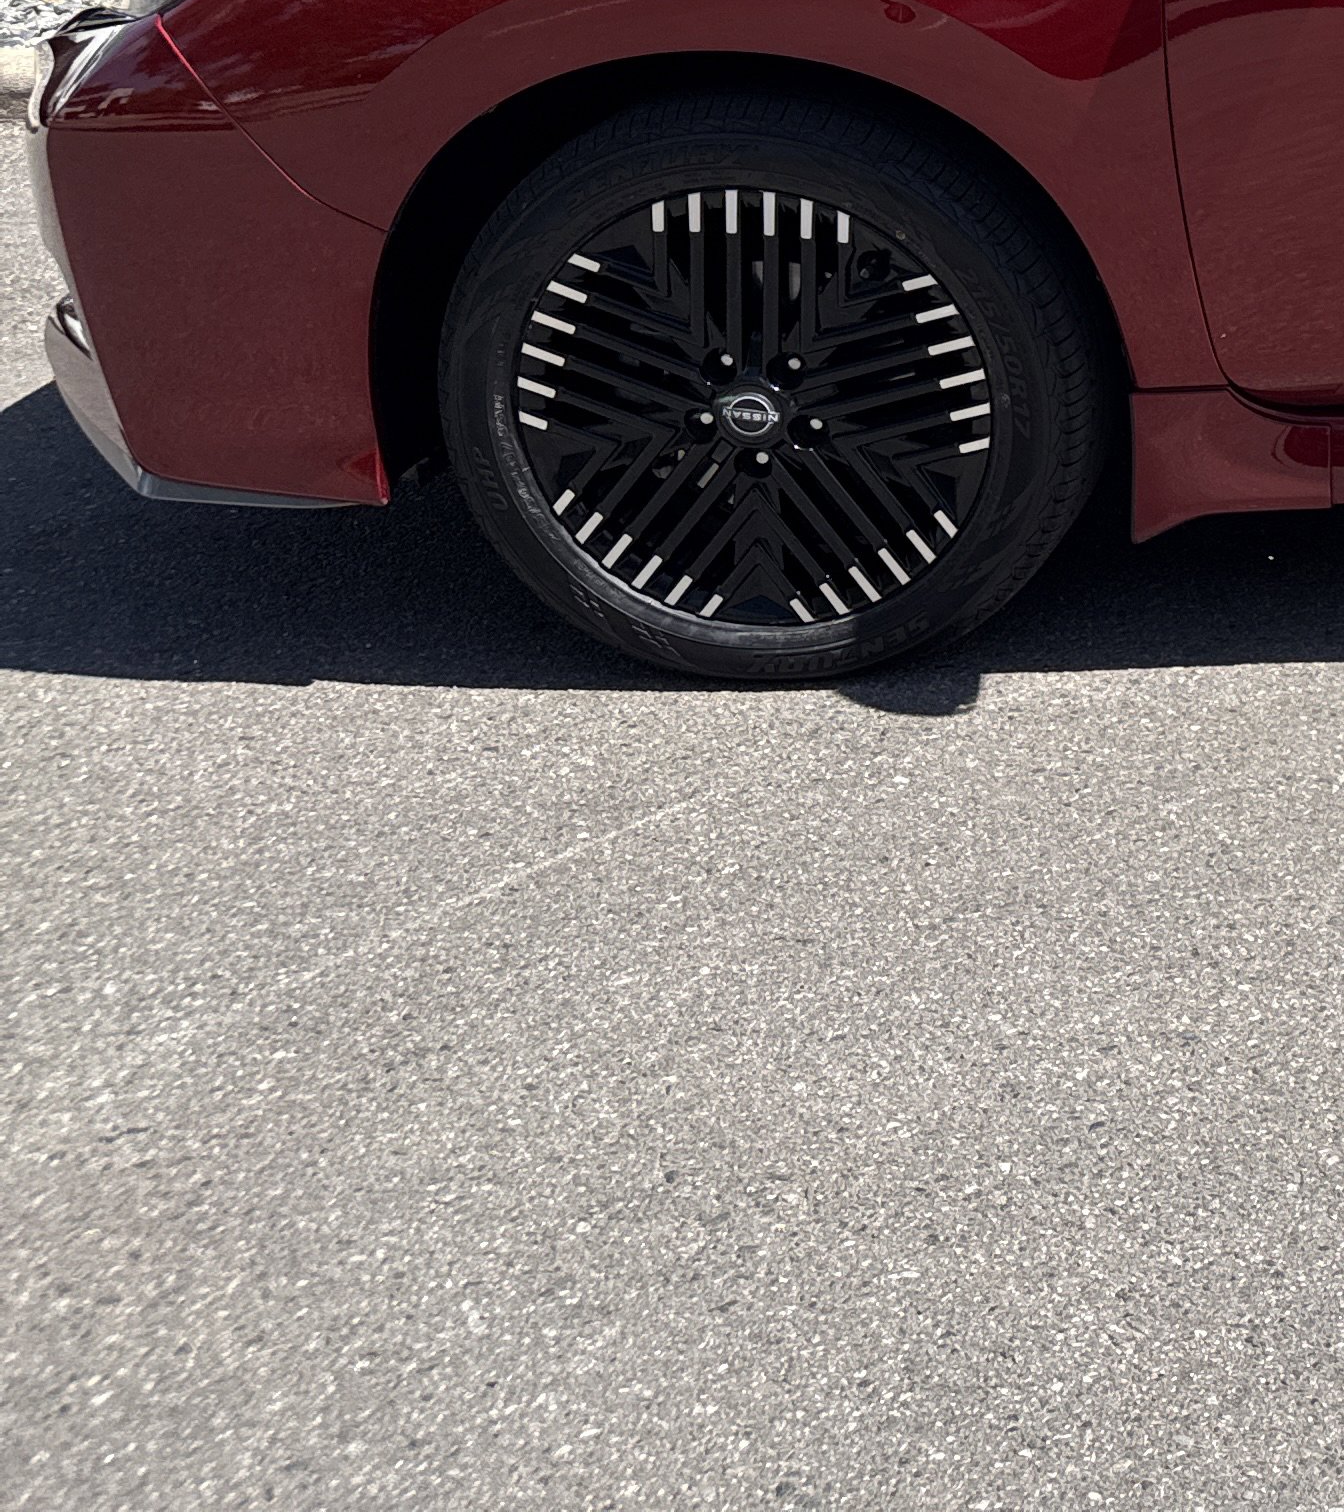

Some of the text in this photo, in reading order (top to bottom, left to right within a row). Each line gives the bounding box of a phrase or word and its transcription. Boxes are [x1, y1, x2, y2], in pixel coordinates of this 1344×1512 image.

[954, 268, 1032, 441] 215/50R17
[722, 406, 780, 423] NISSAN
[472, 445, 510, 512] UHP
[746, 612, 930, 674] SENTURY
